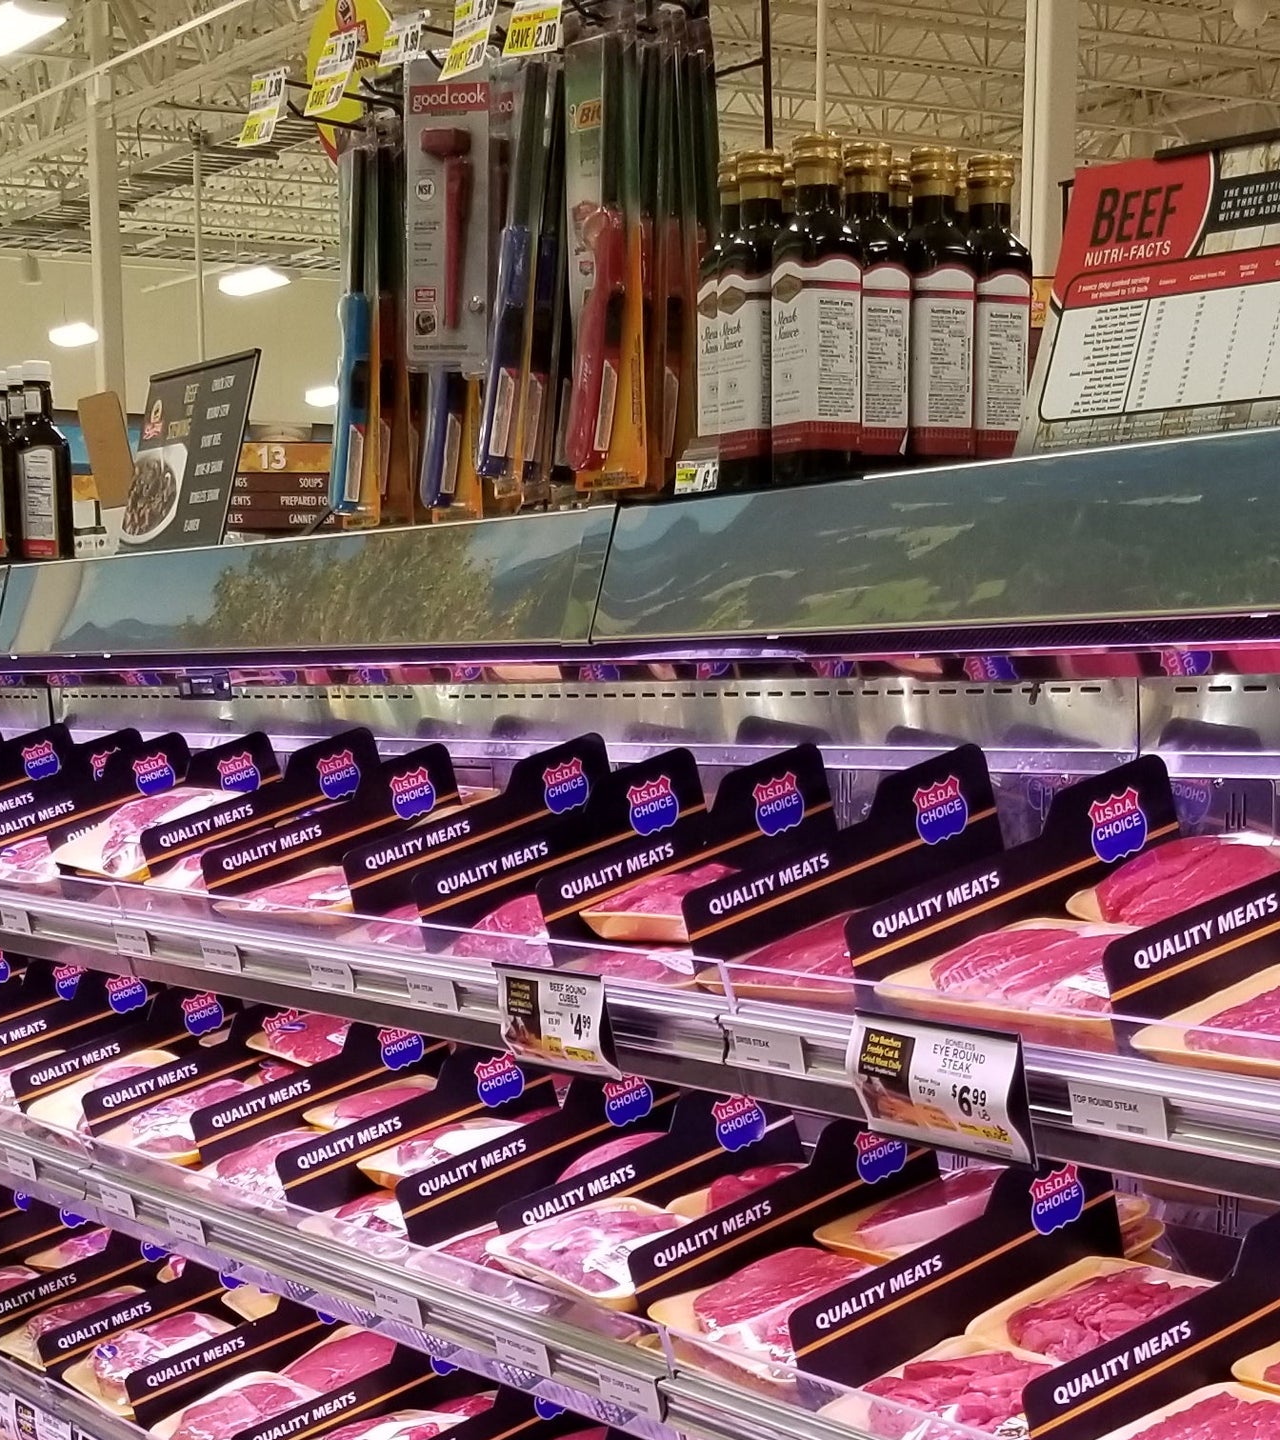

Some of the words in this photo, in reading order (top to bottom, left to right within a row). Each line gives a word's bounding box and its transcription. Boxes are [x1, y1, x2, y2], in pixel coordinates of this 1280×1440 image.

[507, 27, 529, 49] SAVE
[412, 88, 449, 112] good
[450, 84, 485, 104] cook
[1224, 186, 1240, 197] THE
[1221, 199, 1233, 210] ON
[1236, 194, 1263, 208] THREE
[1091, 183, 1182, 247] BEEF
[1219, 210, 1240, 222] WITH
[1243, 207, 1255, 217] NO
[1084, 240, 1171, 267] NUTRI-FACTS
[774, 308, 798, 326] Steak
[775, 327, 799, 342] Sauce
[257, 447, 286, 470] 13
[299, 478, 323, 488] SOUPS
[280, 496, 315, 505] PREPARED
[1134, 917, 1215, 972] QUALITY
[1217, 892, 1279, 937] MEATS
[933, 1044, 950, 1056] EYE
[952, 1049, 986, 1065] ROUND
[941, 1058, 972, 1074] STEAK
[1053, 1350, 1133, 1405] QUALITY
[1134, 1321, 1192, 1368] MEATS
